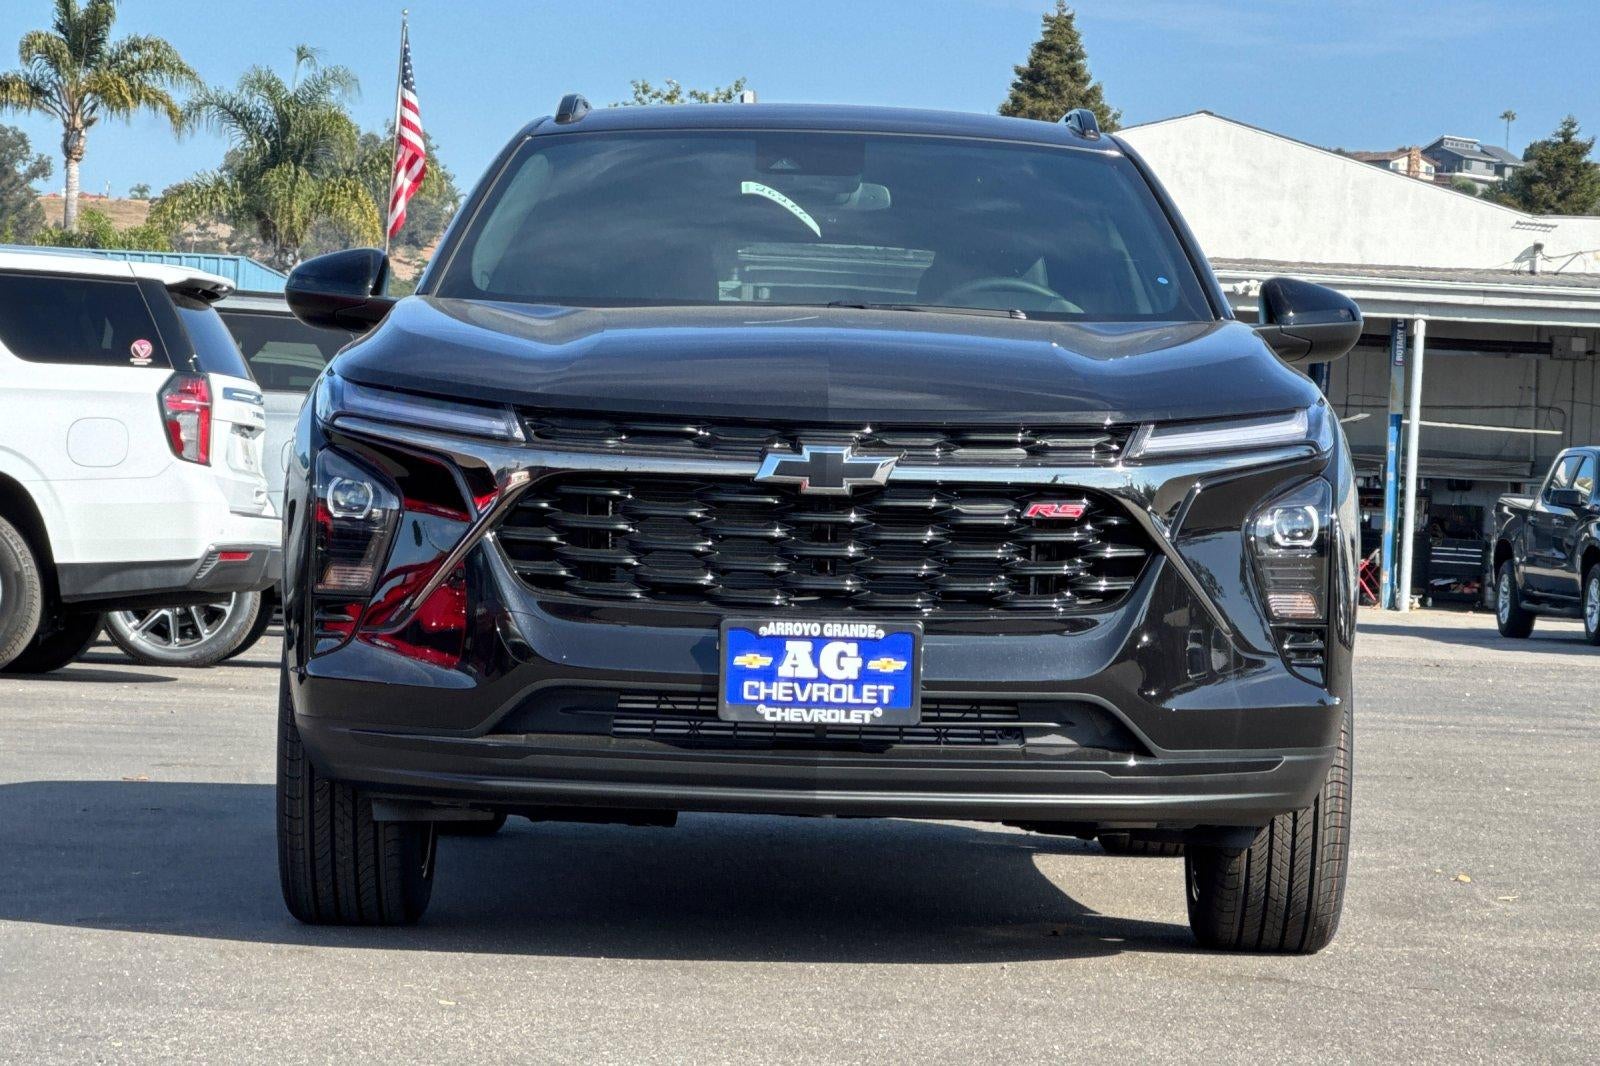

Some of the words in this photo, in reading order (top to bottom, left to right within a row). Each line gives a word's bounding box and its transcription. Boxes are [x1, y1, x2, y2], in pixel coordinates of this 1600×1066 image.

[1395, 329, 1404, 361] ROTARY
[1025, 503, 1086, 518] RS
[768, 622, 821, 637] ARROYO
[823, 623, 877, 639] GRANDE
[777, 640, 863, 681] AG
[742, 680, 895, 705] CHEVROLET
[764, 706, 874, 724] CHEVROLET
